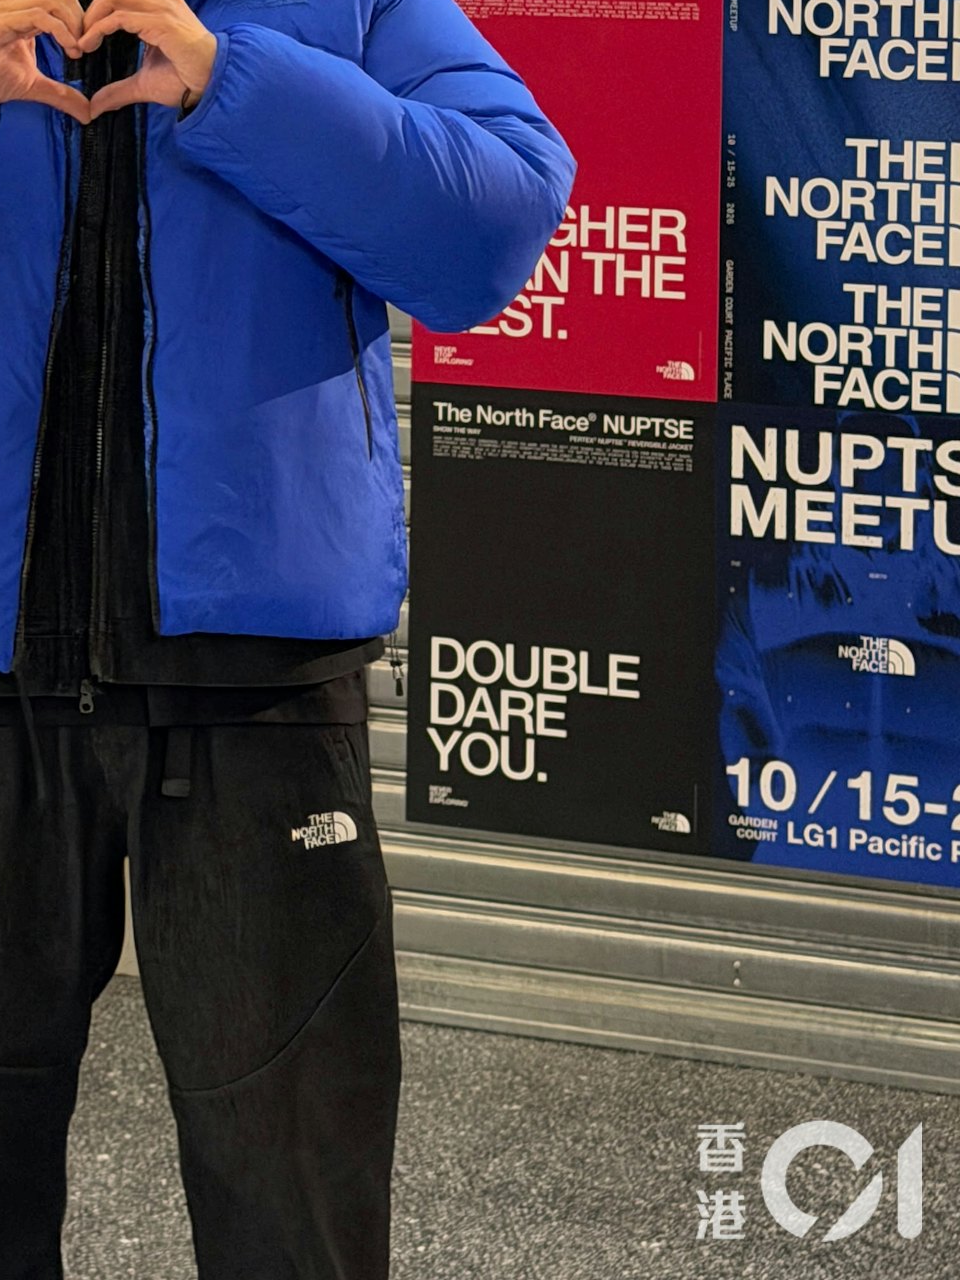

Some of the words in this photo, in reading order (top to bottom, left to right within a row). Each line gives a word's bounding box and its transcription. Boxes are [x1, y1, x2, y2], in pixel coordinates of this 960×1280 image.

[819, 38, 948, 82] FACE
[845, 138, 946, 183] THE
[765, 175, 946, 224] NORTH
[548, 205, 688, 253] GHER
[816, 220, 945, 266] FACE
[582, 251, 687, 299] THE
[468, 294, 568, 340] ST.
[724, 296, 733, 325] COURT
[842, 283, 944, 328] THE
[724, 330, 733, 368] PACIFIC
[763, 320, 943, 370] NORTH
[814, 365, 943, 413] FACE
[433, 401, 472, 423] The
[476, 404, 535, 428] North
[603, 414, 694, 440] NUPTSE
[838, 644, 888, 664] NORTH
[860, 634, 888, 649] THE
[430, 635, 640, 699] DOUBLE
[852, 658, 888, 674] FACE
[430, 682, 567, 738] DARE
[427, 727, 548, 783] YOU.
[291, 823, 334, 841] NORTH
[308, 812, 334, 825] THE
[728, 814, 778, 830] GARDEN
[736, 828, 778, 842] COURT
[304, 834, 335, 850] FACE
[787, 821, 838, 849] LG1
[849, 828, 943, 861] Pacific
